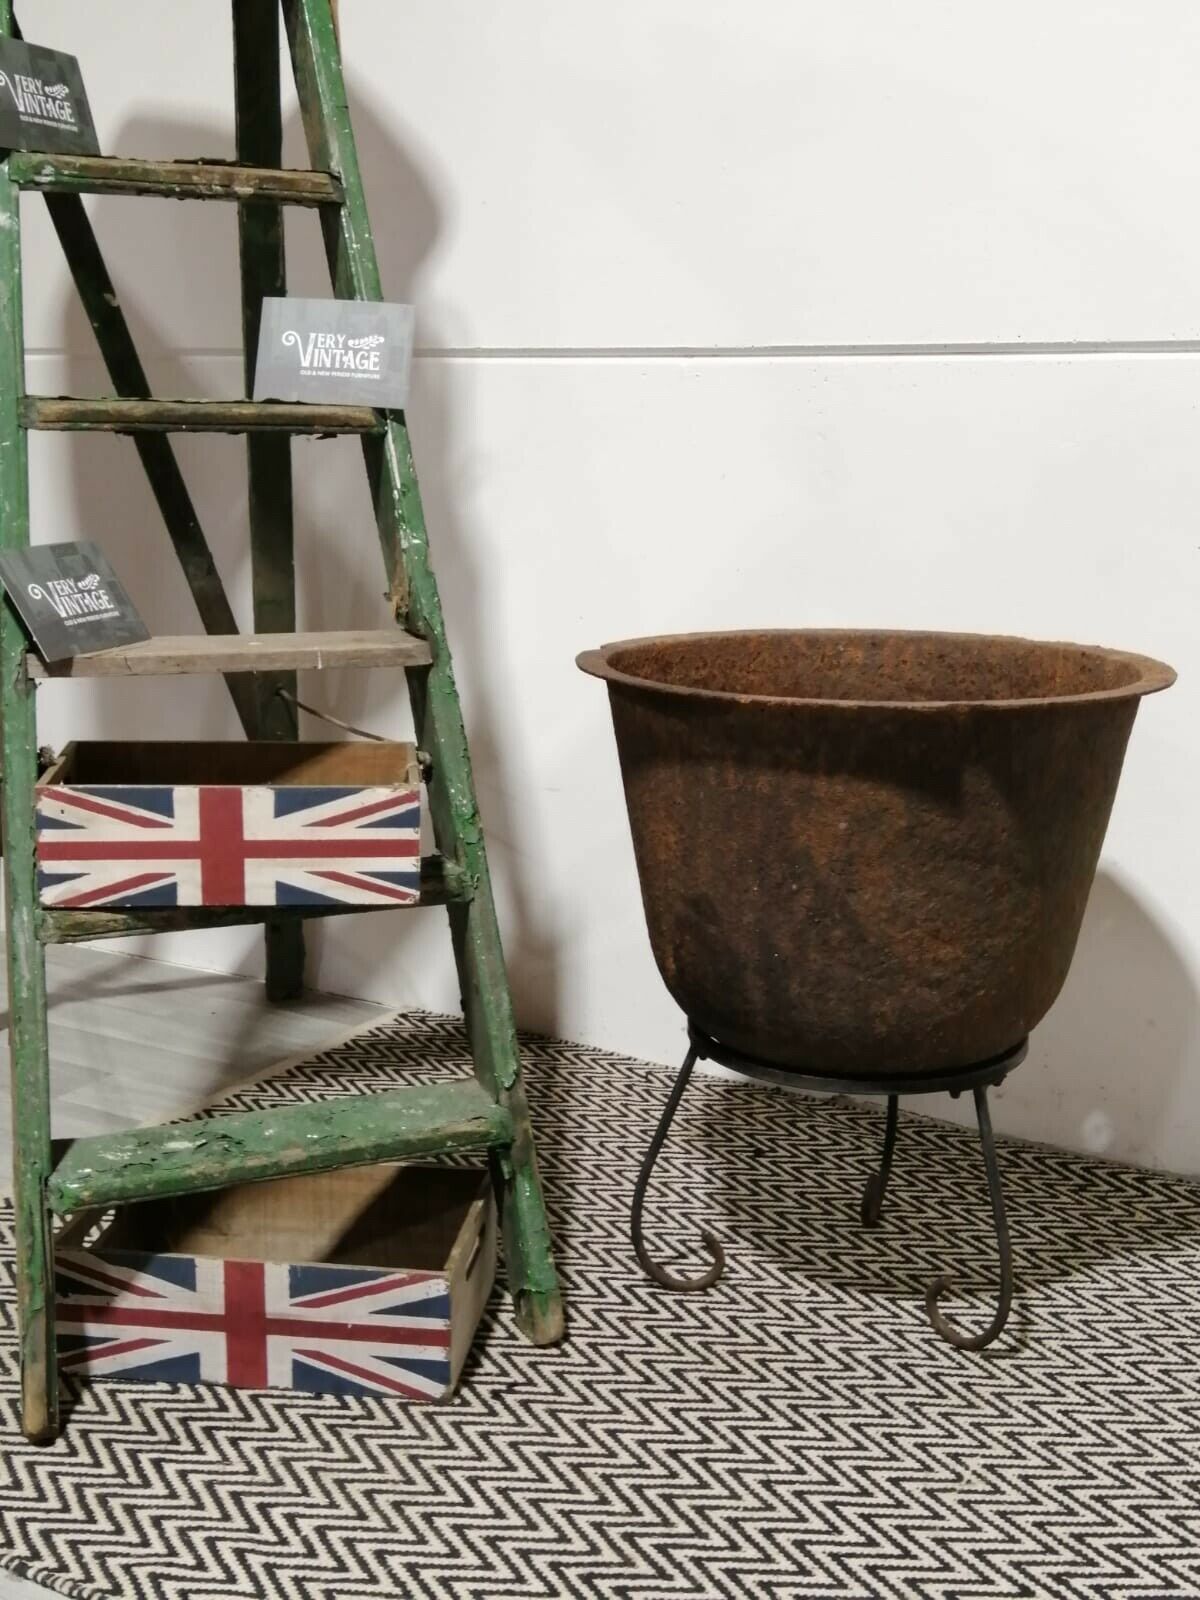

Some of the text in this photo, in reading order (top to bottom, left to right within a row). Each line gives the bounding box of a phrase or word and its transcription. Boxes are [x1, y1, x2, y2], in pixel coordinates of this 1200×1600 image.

[16, 91, 75, 122] VINTAGE
[300, 347, 380, 371] VINTAGE
[56, 589, 114, 618] VINTAGE
